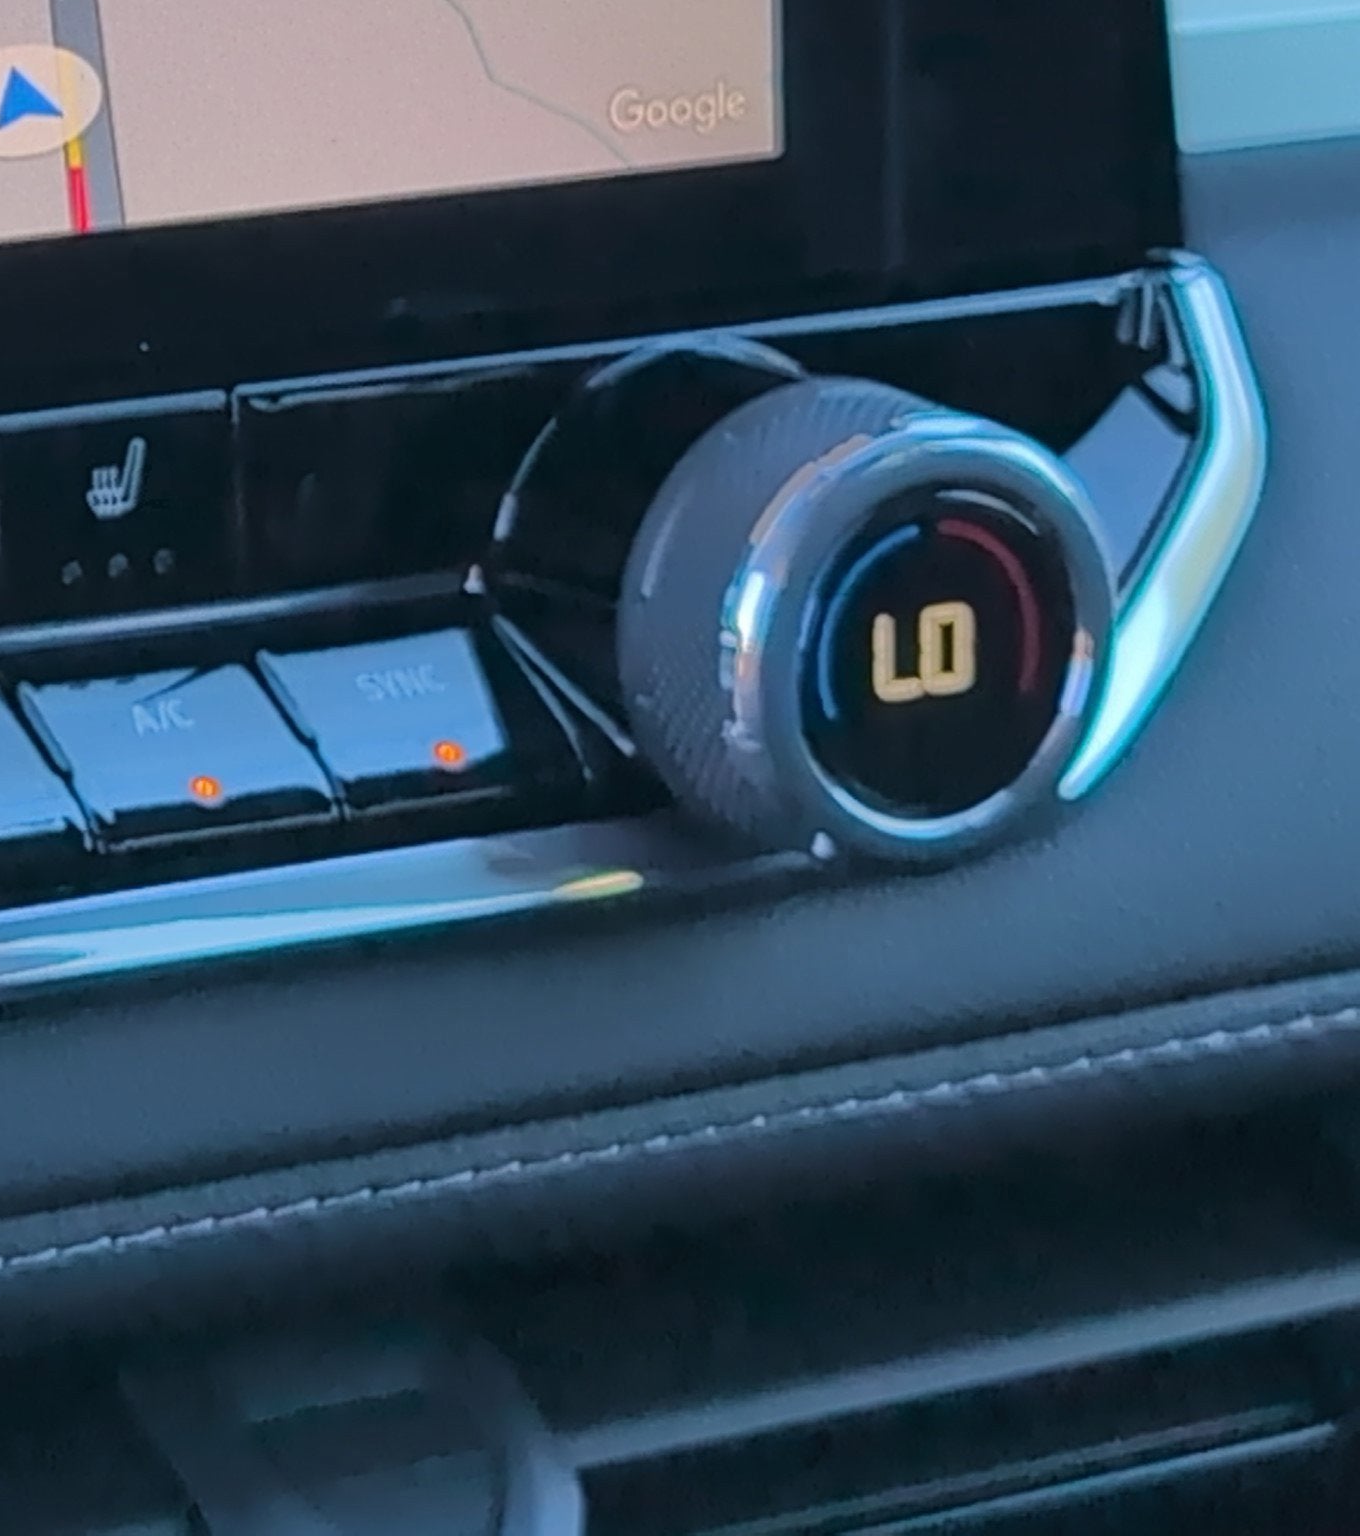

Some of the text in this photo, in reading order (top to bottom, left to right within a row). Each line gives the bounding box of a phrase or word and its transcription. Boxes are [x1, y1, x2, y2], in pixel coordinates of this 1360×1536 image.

[610, 80, 747, 135] Google
[872, 600, 977, 703] LO
[131, 698, 195, 737] A/C
